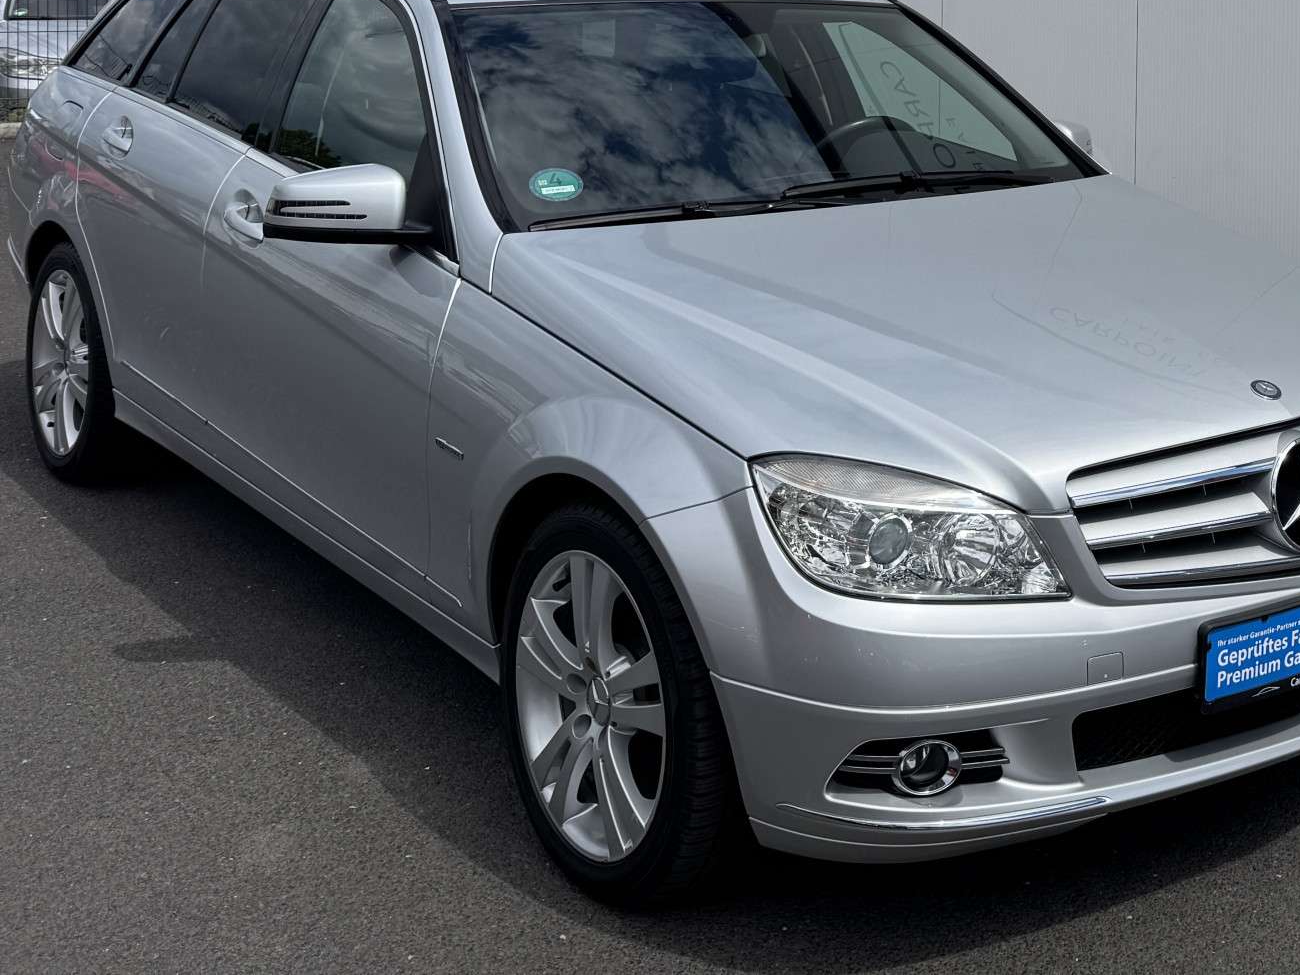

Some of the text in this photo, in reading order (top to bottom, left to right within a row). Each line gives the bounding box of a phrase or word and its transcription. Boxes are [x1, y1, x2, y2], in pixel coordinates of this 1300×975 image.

[1217, 639, 1227, 648] Ihr
[1228, 634, 1249, 645] starker
[1250, 621, 1297, 639] Garantie-Partner
[1217, 637, 1288, 667] Geprüftes
[1217, 660, 1281, 689] Premium
